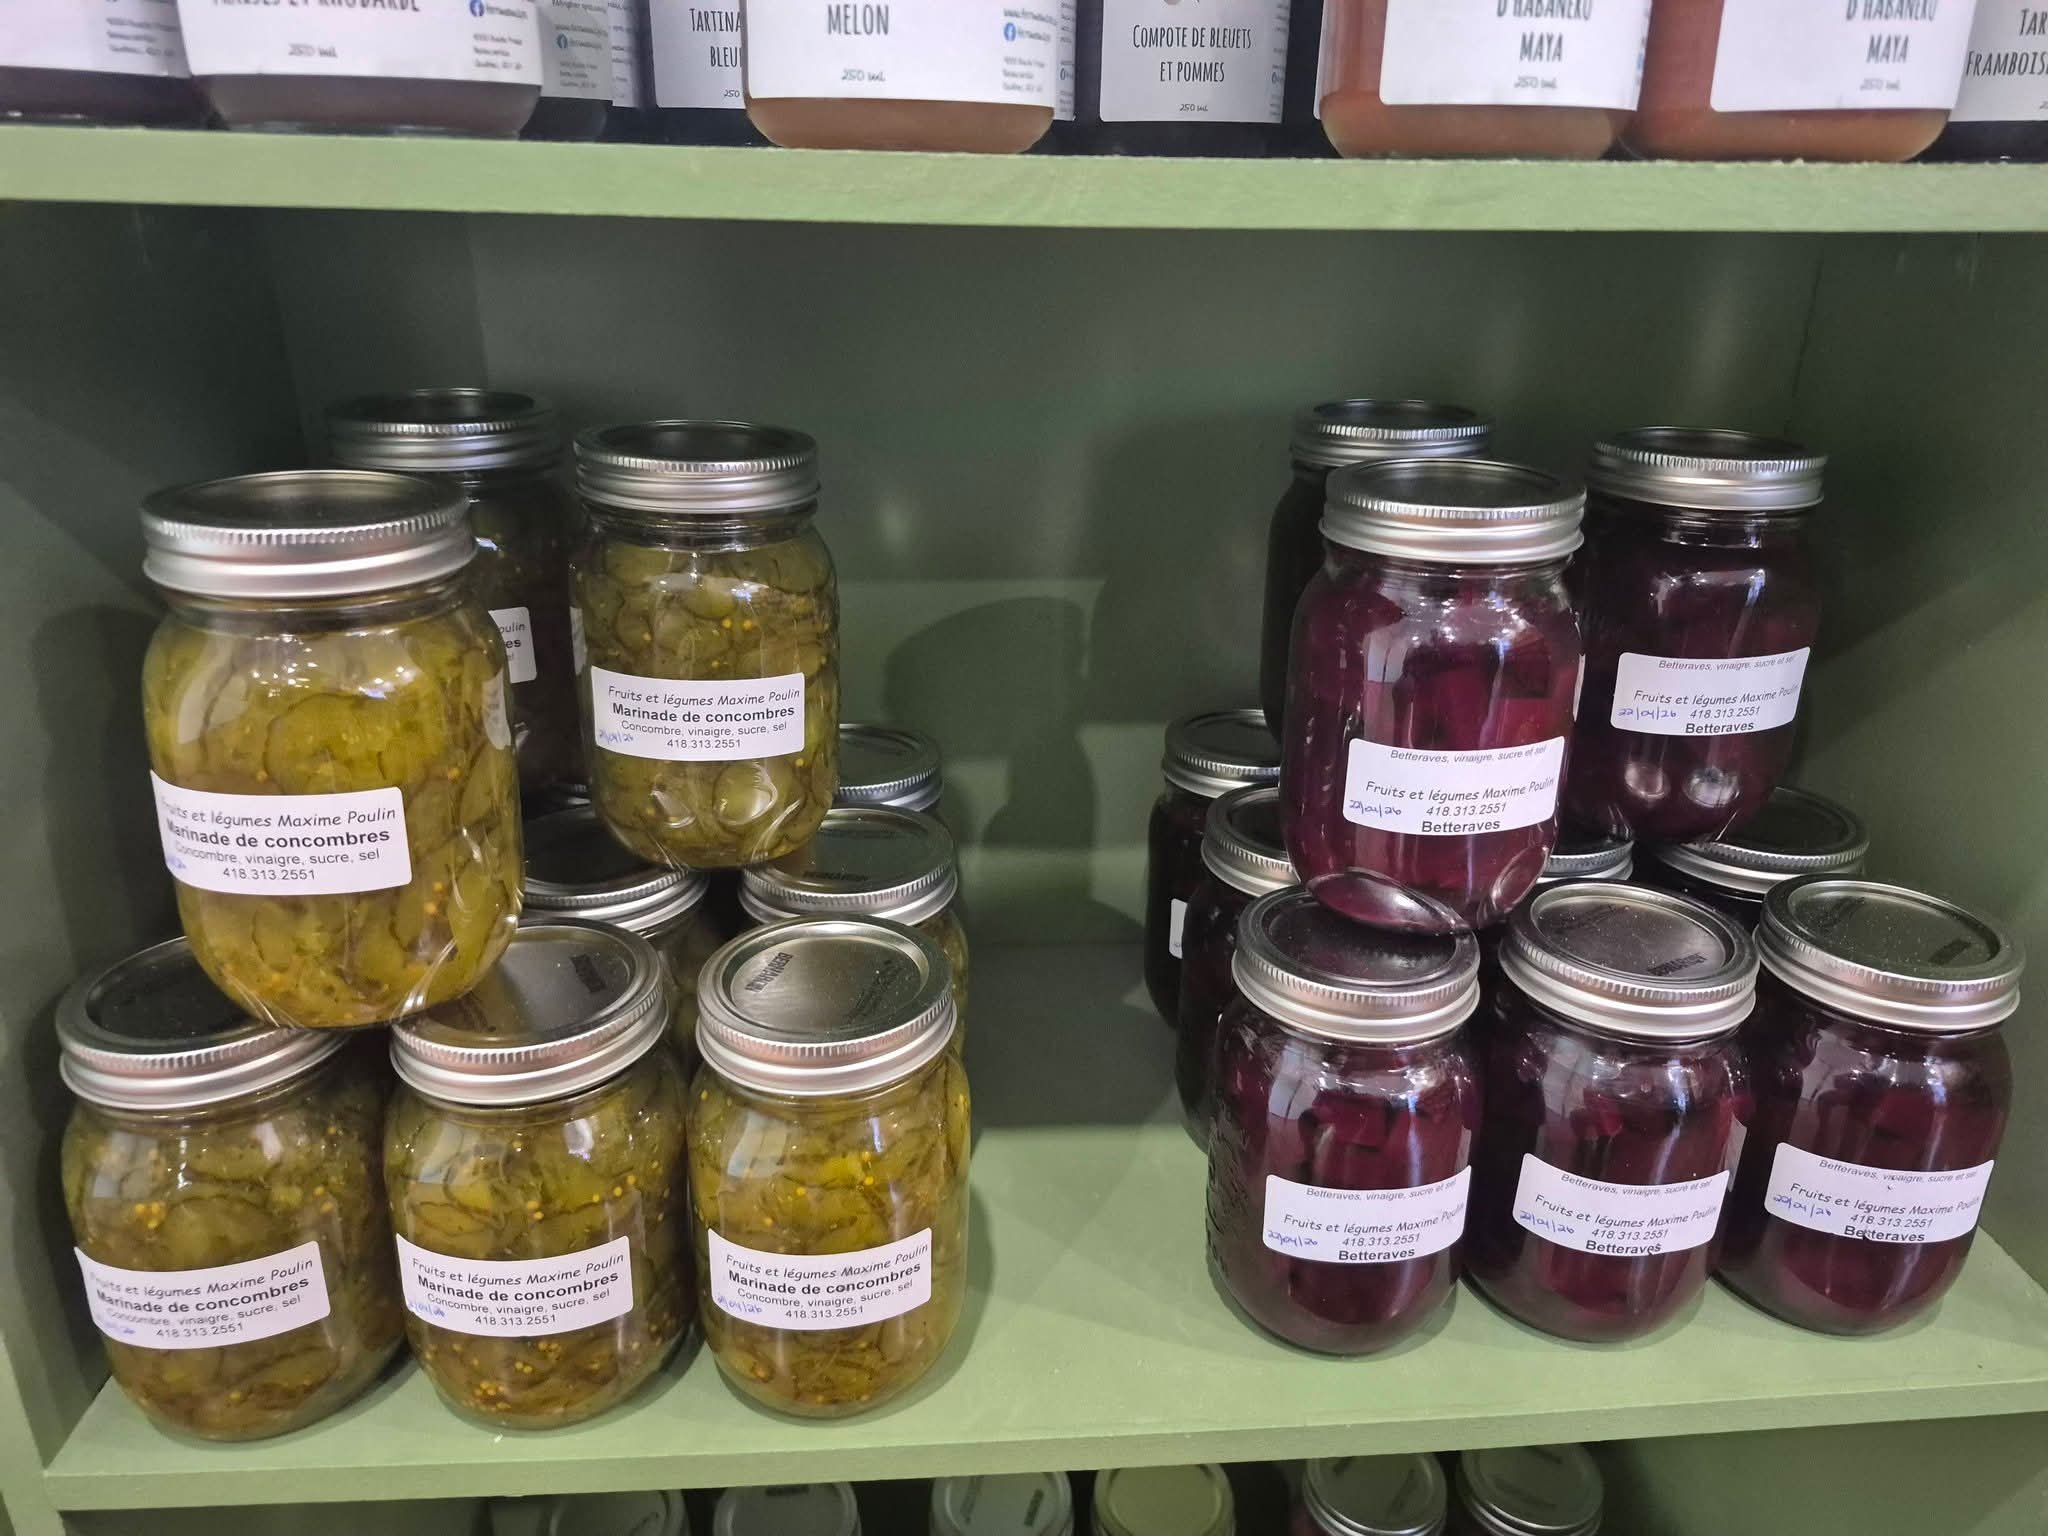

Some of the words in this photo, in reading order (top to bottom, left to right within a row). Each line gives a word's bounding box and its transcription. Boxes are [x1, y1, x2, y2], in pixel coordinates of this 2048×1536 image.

[828, 4, 889, 36] MELON
[1133, 25, 1188, 48] COMPOTE
[1192, 28, 1206, 48] DE
[1210, 28, 1252, 48] BLEUETS
[1520, 32, 1562, 62] MAYA
[1866, 34, 1909, 64] MAYA
[710, 46, 742, 68] BLEU
[1966, 50, 2048, 76] FRAMBOIS
[842, 69, 864, 81] 250
[1160, 61, 1173, 82] ET
[1177, 61, 1225, 82] POMMES
[724, 89, 740, 98] 250
[1180, 104, 1196, 112] 250
[500, 621, 526, 633] oulin
[608, 686, 642, 701] Fruits
[646, 693, 658, 703] et
[663, 694, 713, 708] légumes
[717, 694, 765, 705] Maxime
[769, 689, 800, 701] Poulin
[1634, 690, 1671, 704] Fruits
[1675, 695, 1688, 705] et
[1692, 695, 1736, 707] légumes
[1739, 691, 1777, 704] Maxime
[613, 702, 677, 722] Marinade
[682, 711, 700, 722] de
[706, 706, 794, 723] concombres
[1690, 706, 1760, 719] 418.313.2551
[773, 721, 787, 732] sel
[1685, 722, 1754, 734] Betteraves
[667, 739, 741, 749] 418.313.2551
[1498, 750, 1522, 760] sucre
[1366, 781, 1405, 799] Fruits
[1409, 790, 1423, 800] et
[1429, 789, 1478, 804] légumes
[1482, 786, 1525, 800] Maxime
[1529, 777, 1554, 794] Poulin
[1426, 802, 1506, 817] 418.313.2551
[192, 812, 206, 823] et
[211, 813, 271, 829] légumes
[278, 814, 341, 827] Maxime
[348, 808, 396, 824] Poulin
[1421, 821, 1500, 833] Betteraves
[236, 834, 258, 847] de
[265, 829, 390, 848] concombres
[359, 848, 379, 860] sel
[223, 868, 316, 880] 418.313.2551
[1928, 1173, 1953, 1182] sucre
[1409, 1187, 1433, 1198] sucre
[1665, 1184, 1688, 1195] sucre
[1790, 1183, 1831, 1203] Fruits
[1835, 1196, 1850, 1207] et
[1854, 1200, 1906, 1215] légumes
[1909, 1203, 1954, 1215] Maxime
[1535, 1194, 1573, 1217] Fruits
[1577, 1211, 1591, 1222] et
[1595, 1215, 1646, 1229] légumes
[1647, 1214, 1689, 1228] Maxime
[1284, 1214, 1321, 1231] Fruits
[1326, 1223, 1339, 1232] et
[1344, 1222, 1393, 1236] légumes
[1396, 1216, 1439, 1232] Maxime
[1851, 1214, 1934, 1228] 418.313.2551
[1342, 1234, 1420, 1246] 418.313.2551
[1592, 1229, 1669, 1241] 418.313.2551
[1338, 1248, 1415, 1261] Betteraves
[1585, 1240, 1662, 1255] Betteraves
[412, 1258, 445, 1278] Fruits
[450, 1271, 463, 1282] et
[468, 1273, 521, 1287] légumes
[527, 1269, 581, 1285] Maxime
[586, 1253, 624, 1274] Poulin
[726, 1254, 761, 1274] Fruits
[766, 1266, 779, 1277] et
[784, 1268, 837, 1282] légumes
[841, 1260, 891, 1277] Maxime
[895, 1244, 928, 1265] Poulin
[125, 1285, 138, 1296] et
[144, 1286, 201, 1300] légumes
[207, 1276, 265, 1295] Maxime
[271, 1259, 313, 1280] Poulin
[418, 1275, 483, 1301] Marinade
[489, 1289, 508, 1301] de
[514, 1271, 618, 1301] concombres
[729, 1270, 796, 1295] Marinade
[801, 1283, 820, 1295] de
[826, 1262, 921, 1294] concombres
[898, 1280, 913, 1292] sel
[168, 1301, 189, 1313] de
[195, 1278, 309, 1312] concombres
[282, 1295, 300, 1308] sel
[593, 1289, 610, 1301] sel
[475, 1314, 556, 1325] 418.313.2551
[785, 1306, 863, 1318] 418.313.2551
[156, 1323, 243, 1338] 418.313.2551
